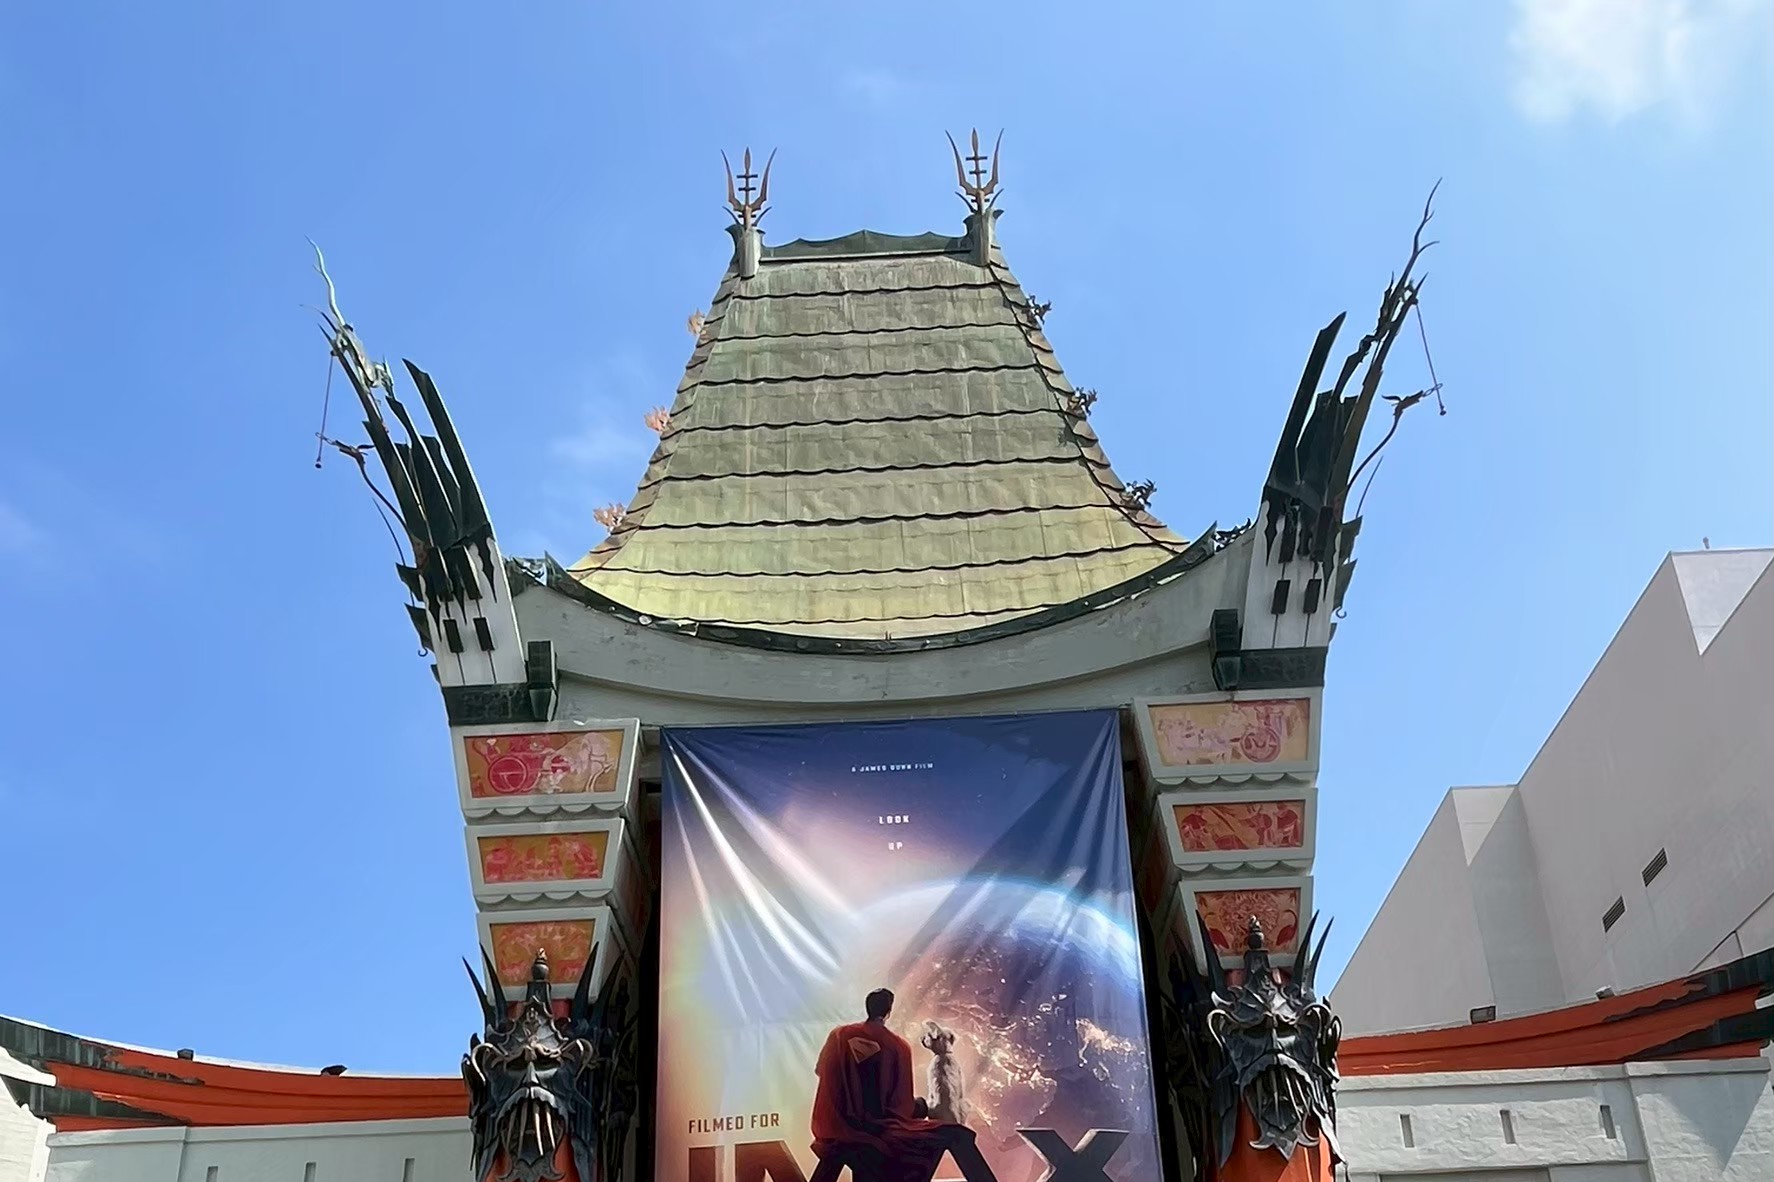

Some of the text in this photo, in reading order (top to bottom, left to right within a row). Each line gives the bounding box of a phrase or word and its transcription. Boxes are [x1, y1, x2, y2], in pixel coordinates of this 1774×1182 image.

[879, 815, 910, 824] LOOK
[888, 842, 903, 850] UP
[688, 1113, 780, 1134] FILMED FOR
